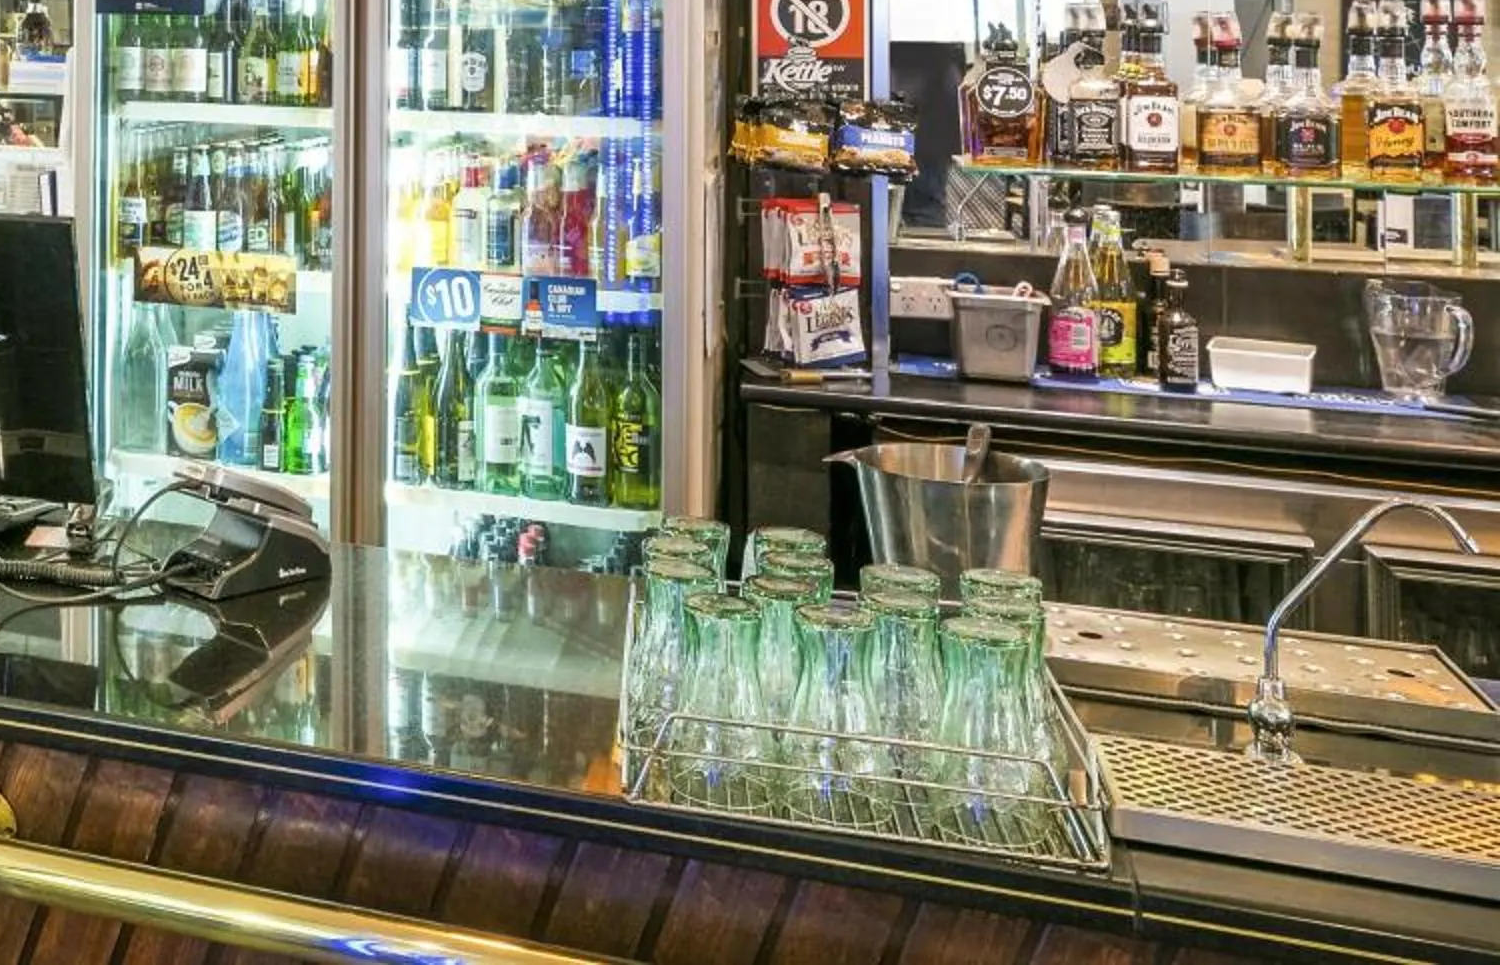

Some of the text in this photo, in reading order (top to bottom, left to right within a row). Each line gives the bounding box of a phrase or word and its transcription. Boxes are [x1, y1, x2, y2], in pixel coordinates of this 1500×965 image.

[788, 0, 829, 34] 18
[762, 58, 833, 88] Kettle
[982, 86, 1028, 106] $7.50
[1450, 119, 1492, 129] COMFORT
[425, 276, 475, 318] $10
[173, 376, 203, 393] MILK
